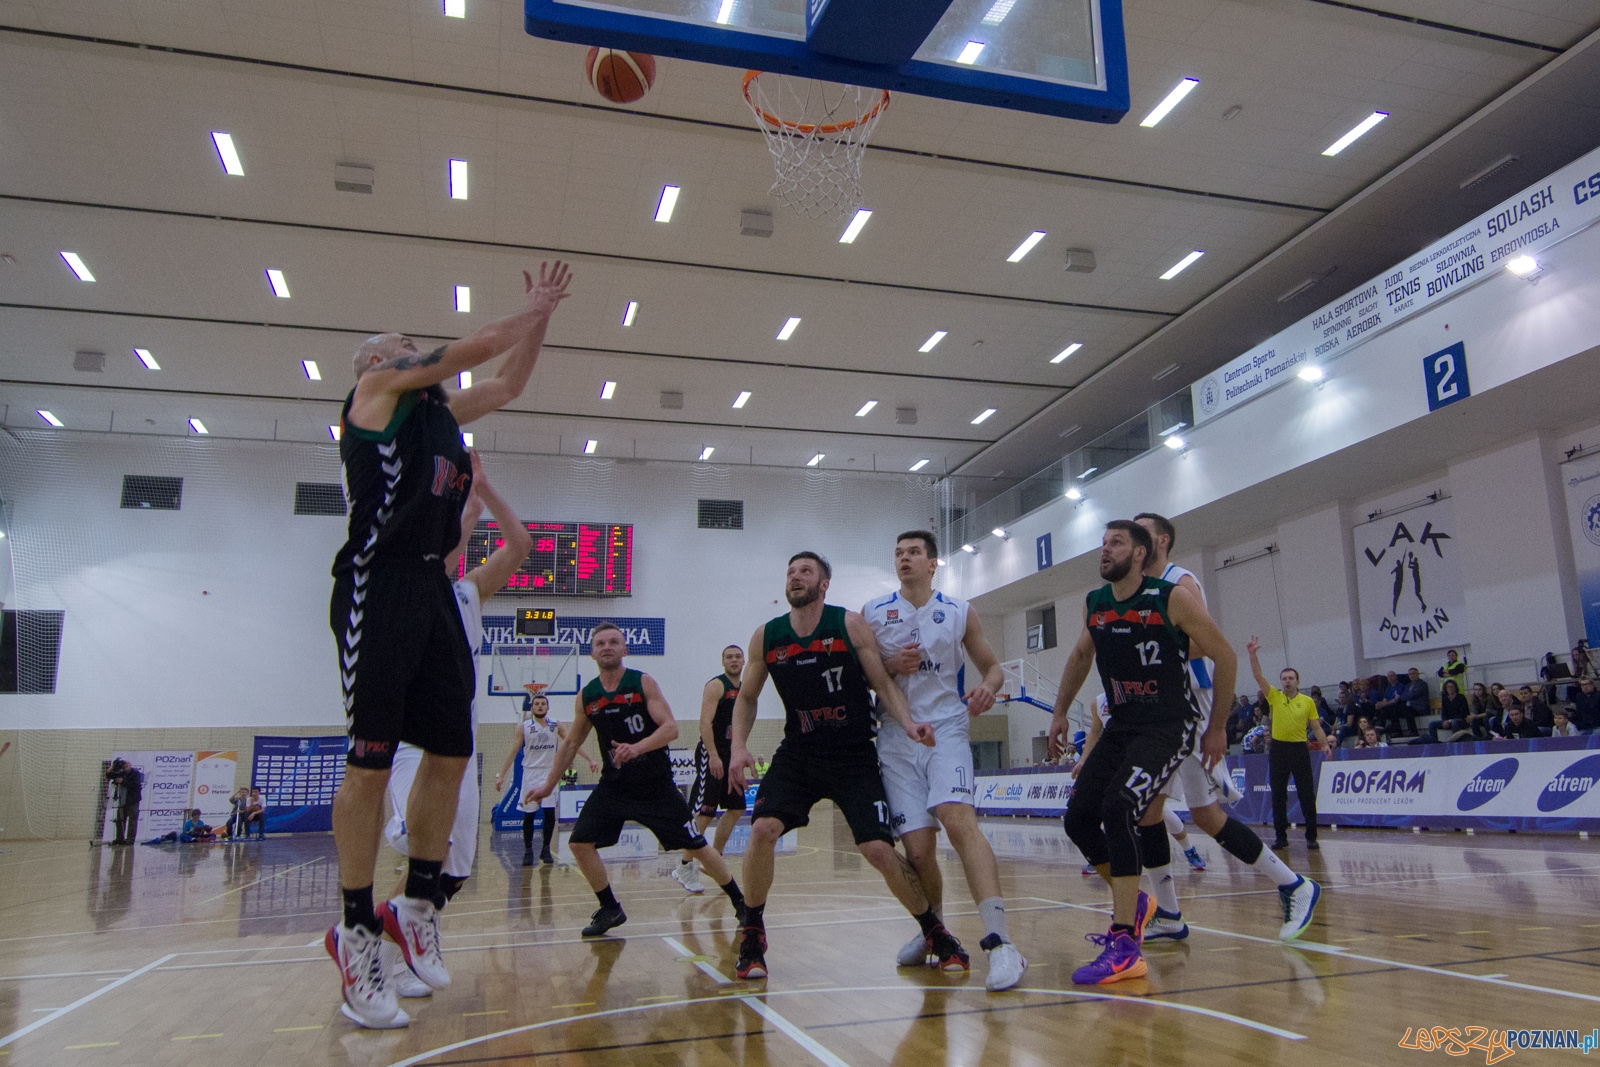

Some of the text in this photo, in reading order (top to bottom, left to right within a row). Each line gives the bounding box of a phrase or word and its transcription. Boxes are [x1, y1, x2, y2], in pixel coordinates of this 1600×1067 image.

[1487, 185, 1555, 238] SQUASH
[1490, 217, 1560, 263] ERGOWIOSŁA
[1436, 244, 1477, 274] SIŁOWNIA
[1384, 270, 1404, 290] JUDO
[1426, 254, 1486, 298] BOWLING
[1385, 276, 1421, 307] TENIS
[1312, 285, 1379, 331] HALA SPORTOWA
[1358, 300, 1379, 318] SZACHY
[1393, 298, 1415, 315] KARATE
[1346, 312, 1382, 341] AEROBIK
[1314, 336, 1340, 357] BOISKA
[1224, 348, 1276, 384] Centrum Sportu
[1225, 348, 1308, 401] Politechniki Poznańskiej
[1434, 353, 1458, 402] 2
[537, 539, 555, 552] 35
[1040, 538, 1047, 566] 1
[1111, 626, 1132, 634] hummel
[1379, 607, 1450, 644] POZNAŃ
[1134, 640, 1162, 666] 12
[821, 666, 844, 693] 17
[1121, 680, 1159, 696] PEC
[624, 713, 645, 734] 10
[810, 705, 847, 721] PEC
[1125, 765, 1152, 798] 12
[1331, 769, 1426, 794] BIOFARM
[1467, 776, 1505, 793] atrem
[1549, 774, 1593, 792] atrem
[1336, 797, 1355, 805] POLSKI
[1357, 797, 1391, 805] PRODUCENT
